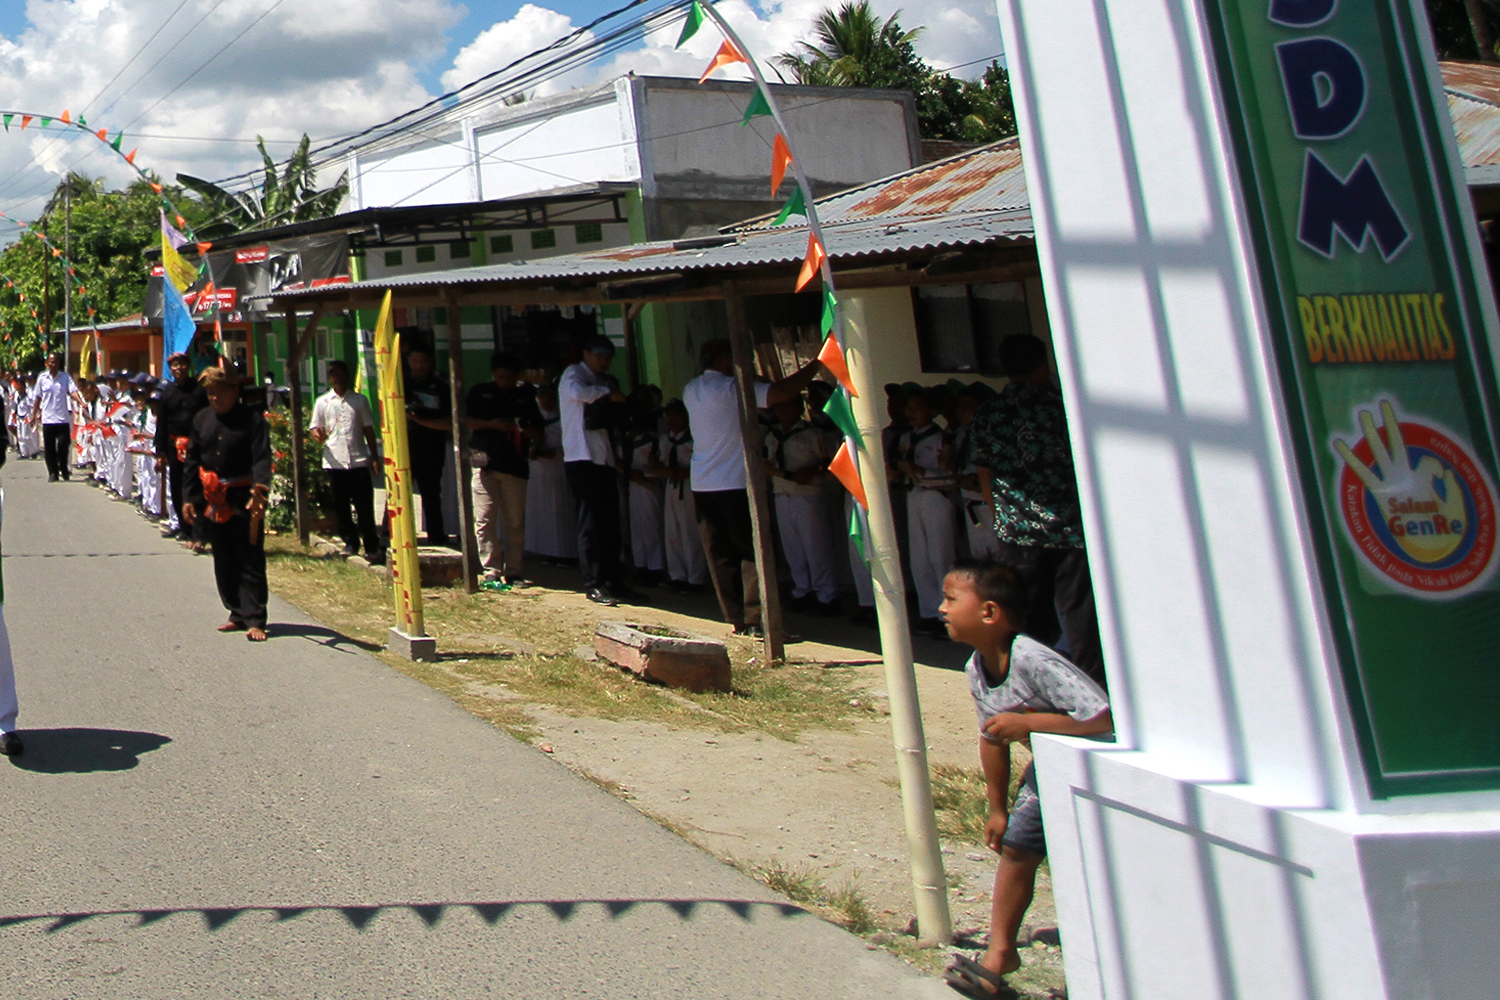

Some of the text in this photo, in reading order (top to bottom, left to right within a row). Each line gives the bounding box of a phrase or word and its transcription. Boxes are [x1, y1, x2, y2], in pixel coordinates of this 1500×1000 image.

[1297, 293, 1455, 364] BERKUALITAS
[1388, 496, 1439, 514] Salam
[1388, 514, 1463, 537] GenRe
[1347, 484, 1364, 533] Katakan
[1362, 535, 1387, 565] Tidak
[1387, 563, 1414, 584] pada
[1416, 574, 1449, 587] Nikah
